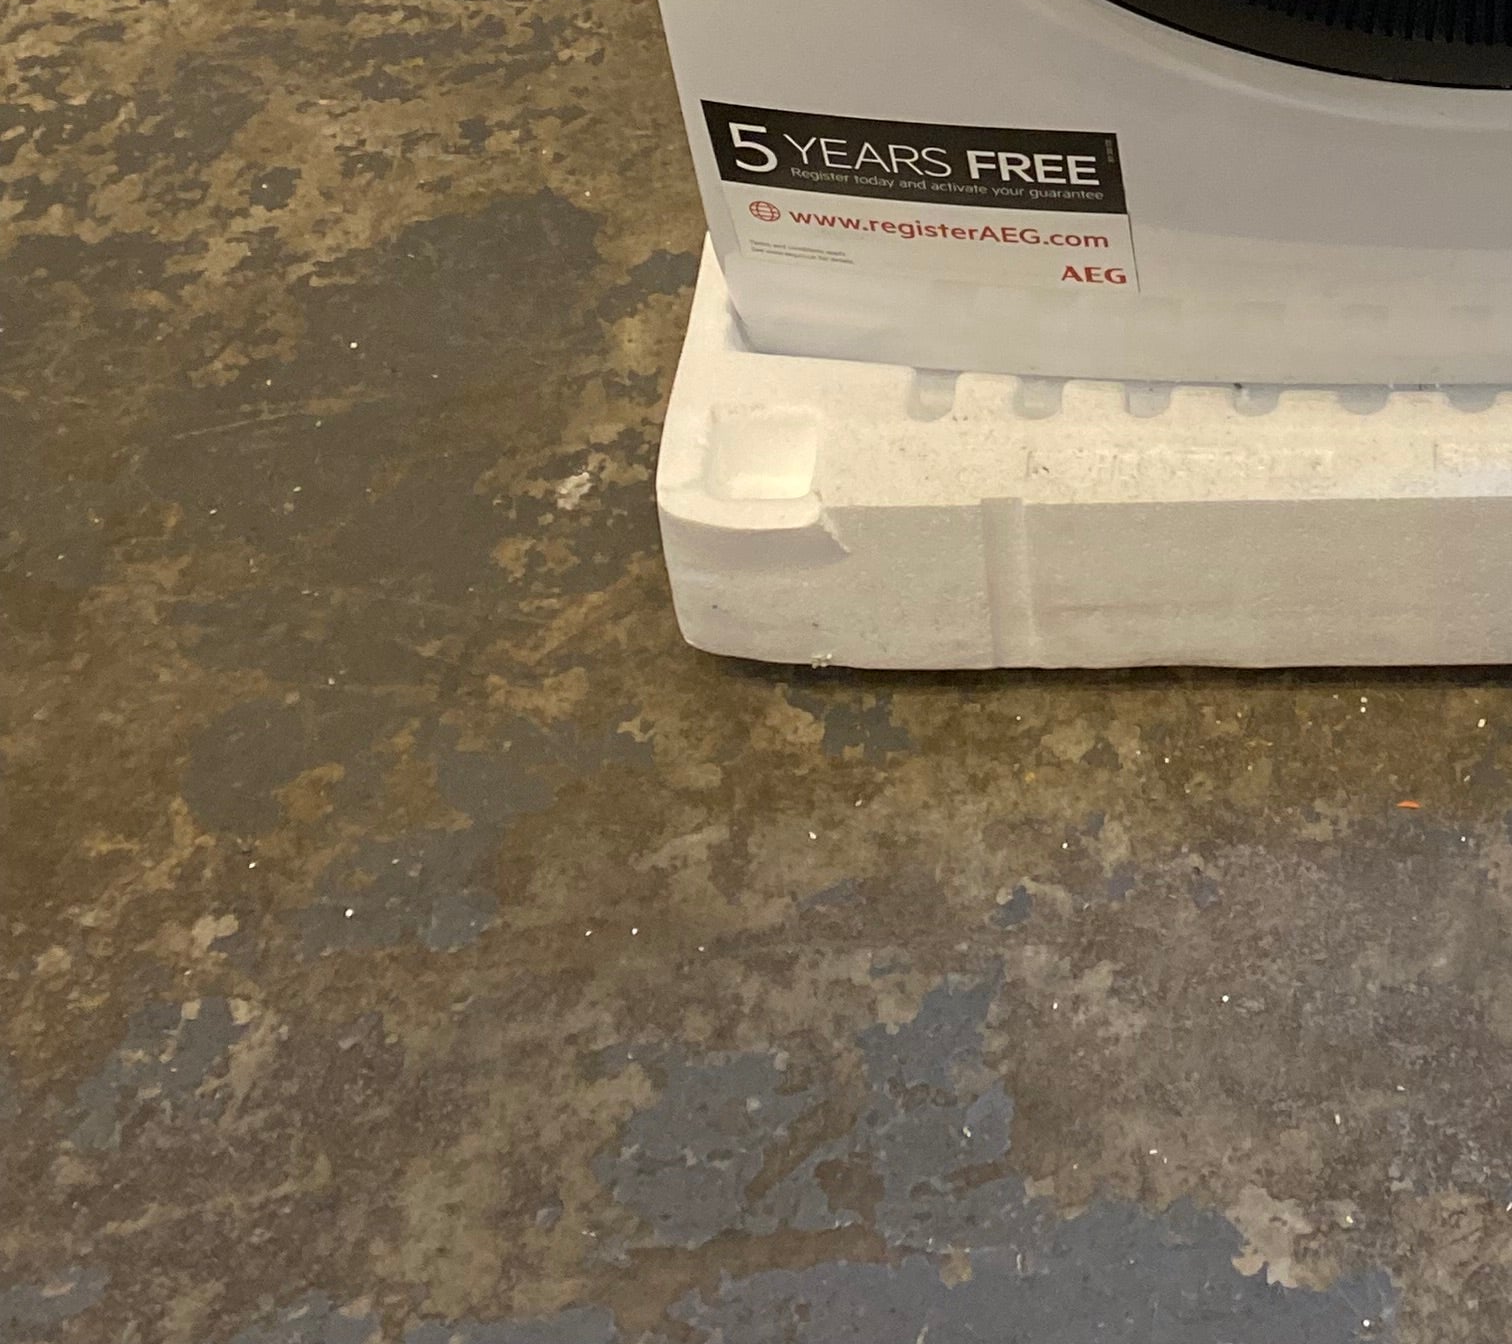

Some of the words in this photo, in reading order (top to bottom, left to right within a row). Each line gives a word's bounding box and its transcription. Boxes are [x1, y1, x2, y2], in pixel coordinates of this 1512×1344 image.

[729, 121, 779, 173] 5
[782, 133, 952, 178] YEARS
[966, 149, 1100, 186] FREE
[791, 167, 849, 183] Register
[854, 175, 894, 188] today
[899, 179, 927, 191] and
[931, 182, 988, 194] activate
[991, 186, 1024, 197] your
[1029, 189, 1104, 201] guarantee
[788, 208, 1109, 248] www.registerAEG.com
[1061, 265, 1127, 285] AEG
